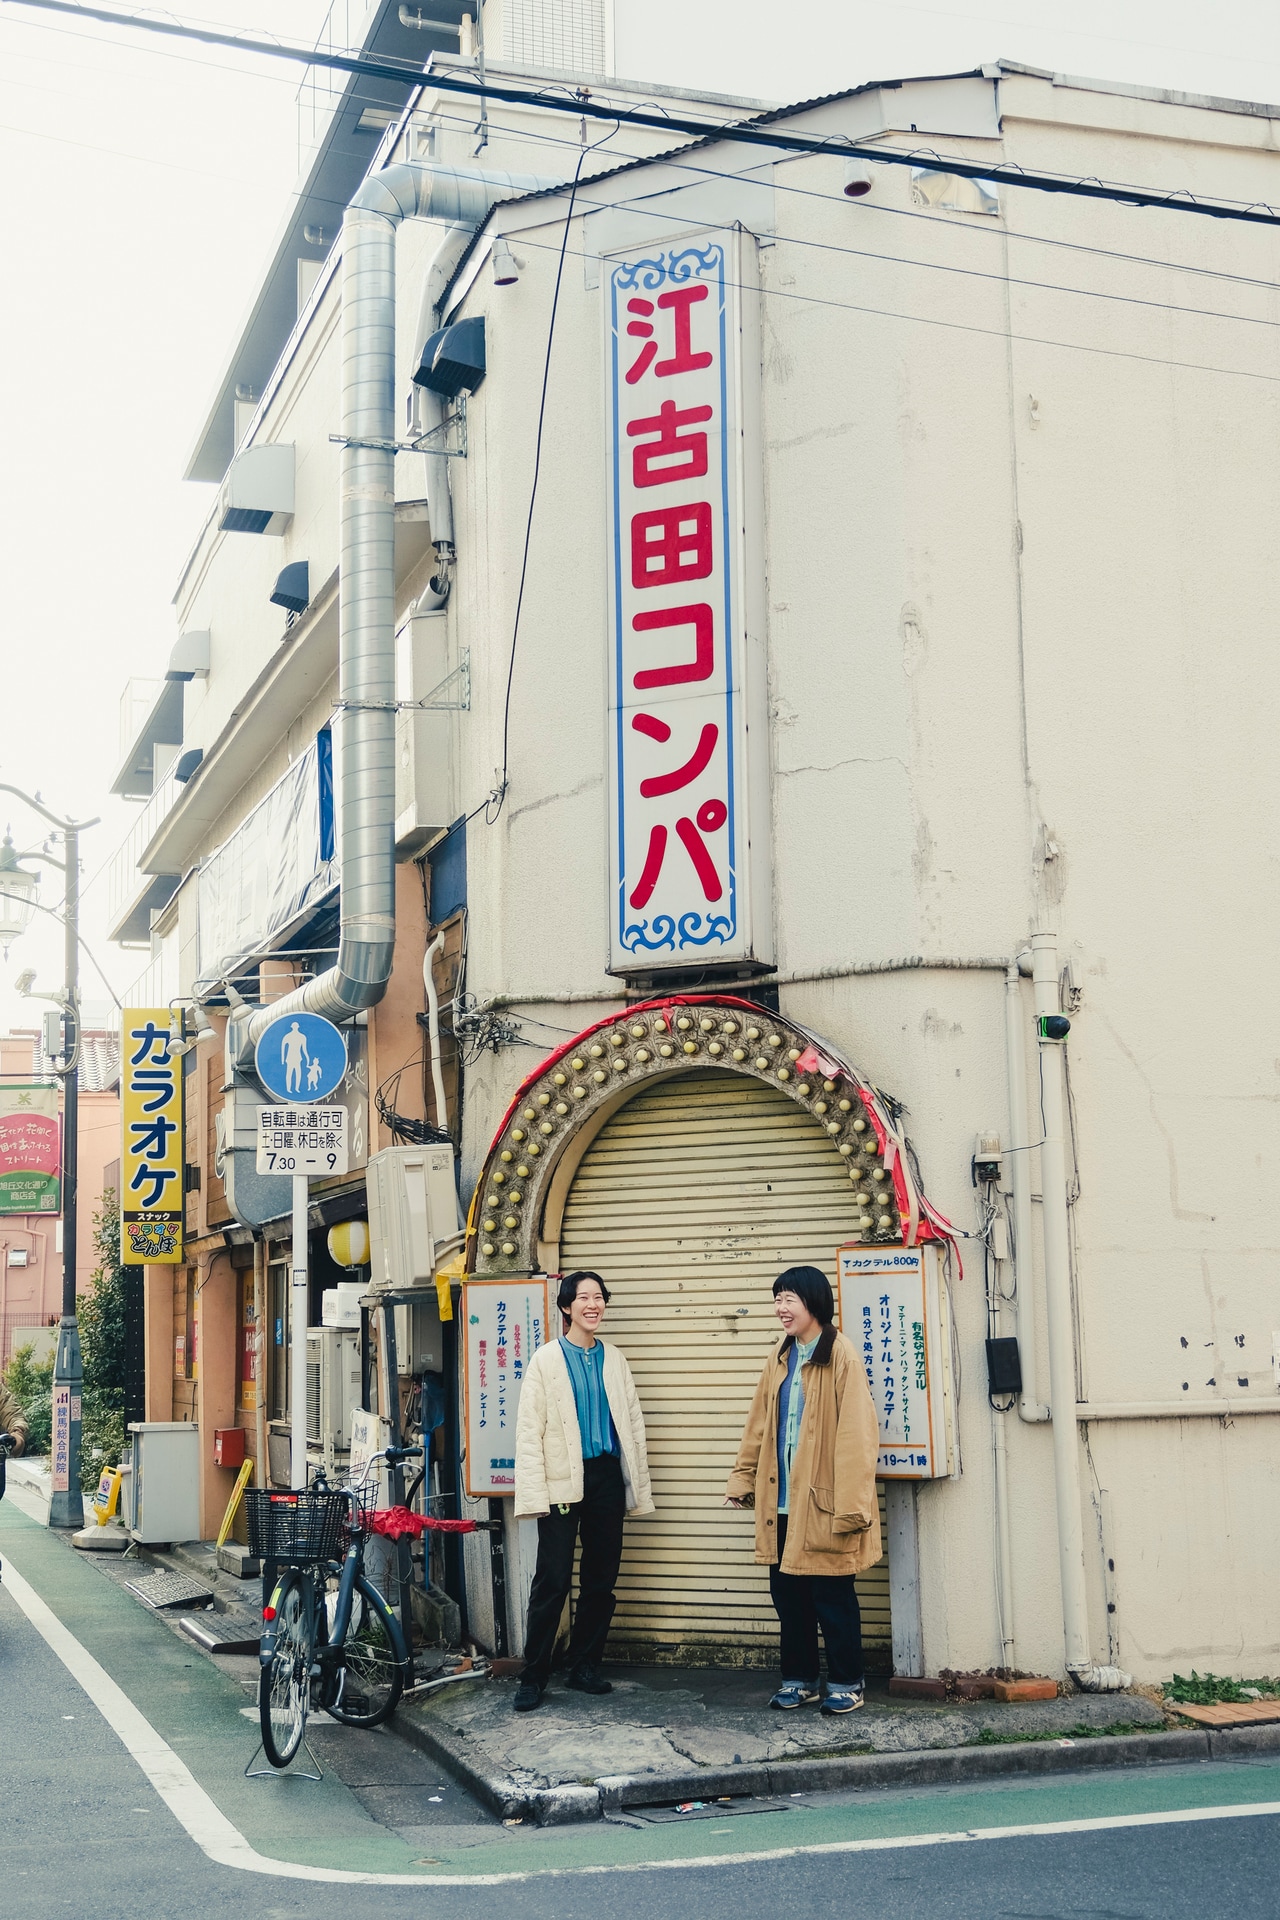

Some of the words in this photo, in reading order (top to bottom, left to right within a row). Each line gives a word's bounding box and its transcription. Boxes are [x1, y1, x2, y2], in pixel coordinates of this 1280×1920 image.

[626, 284, 728, 910] 江古田コンパ
[130, 1022, 177, 1208] カラオケ
[261, 1110, 343, 1128] 自転車は通行可
[4, 1155, 43, 1165] ストリート
[266, 1152, 296, 1170] 7.30
[326, 1152, 337, 1170] 9
[10, 1190, 37, 1201] 商店会
[137, 1212, 171, 1221] スナック
[128, 1223, 179, 1236] カラオケ
[130, 1235, 178, 1257] とんぼ
[55, 1406, 68, 1474] 練馬総合病院
